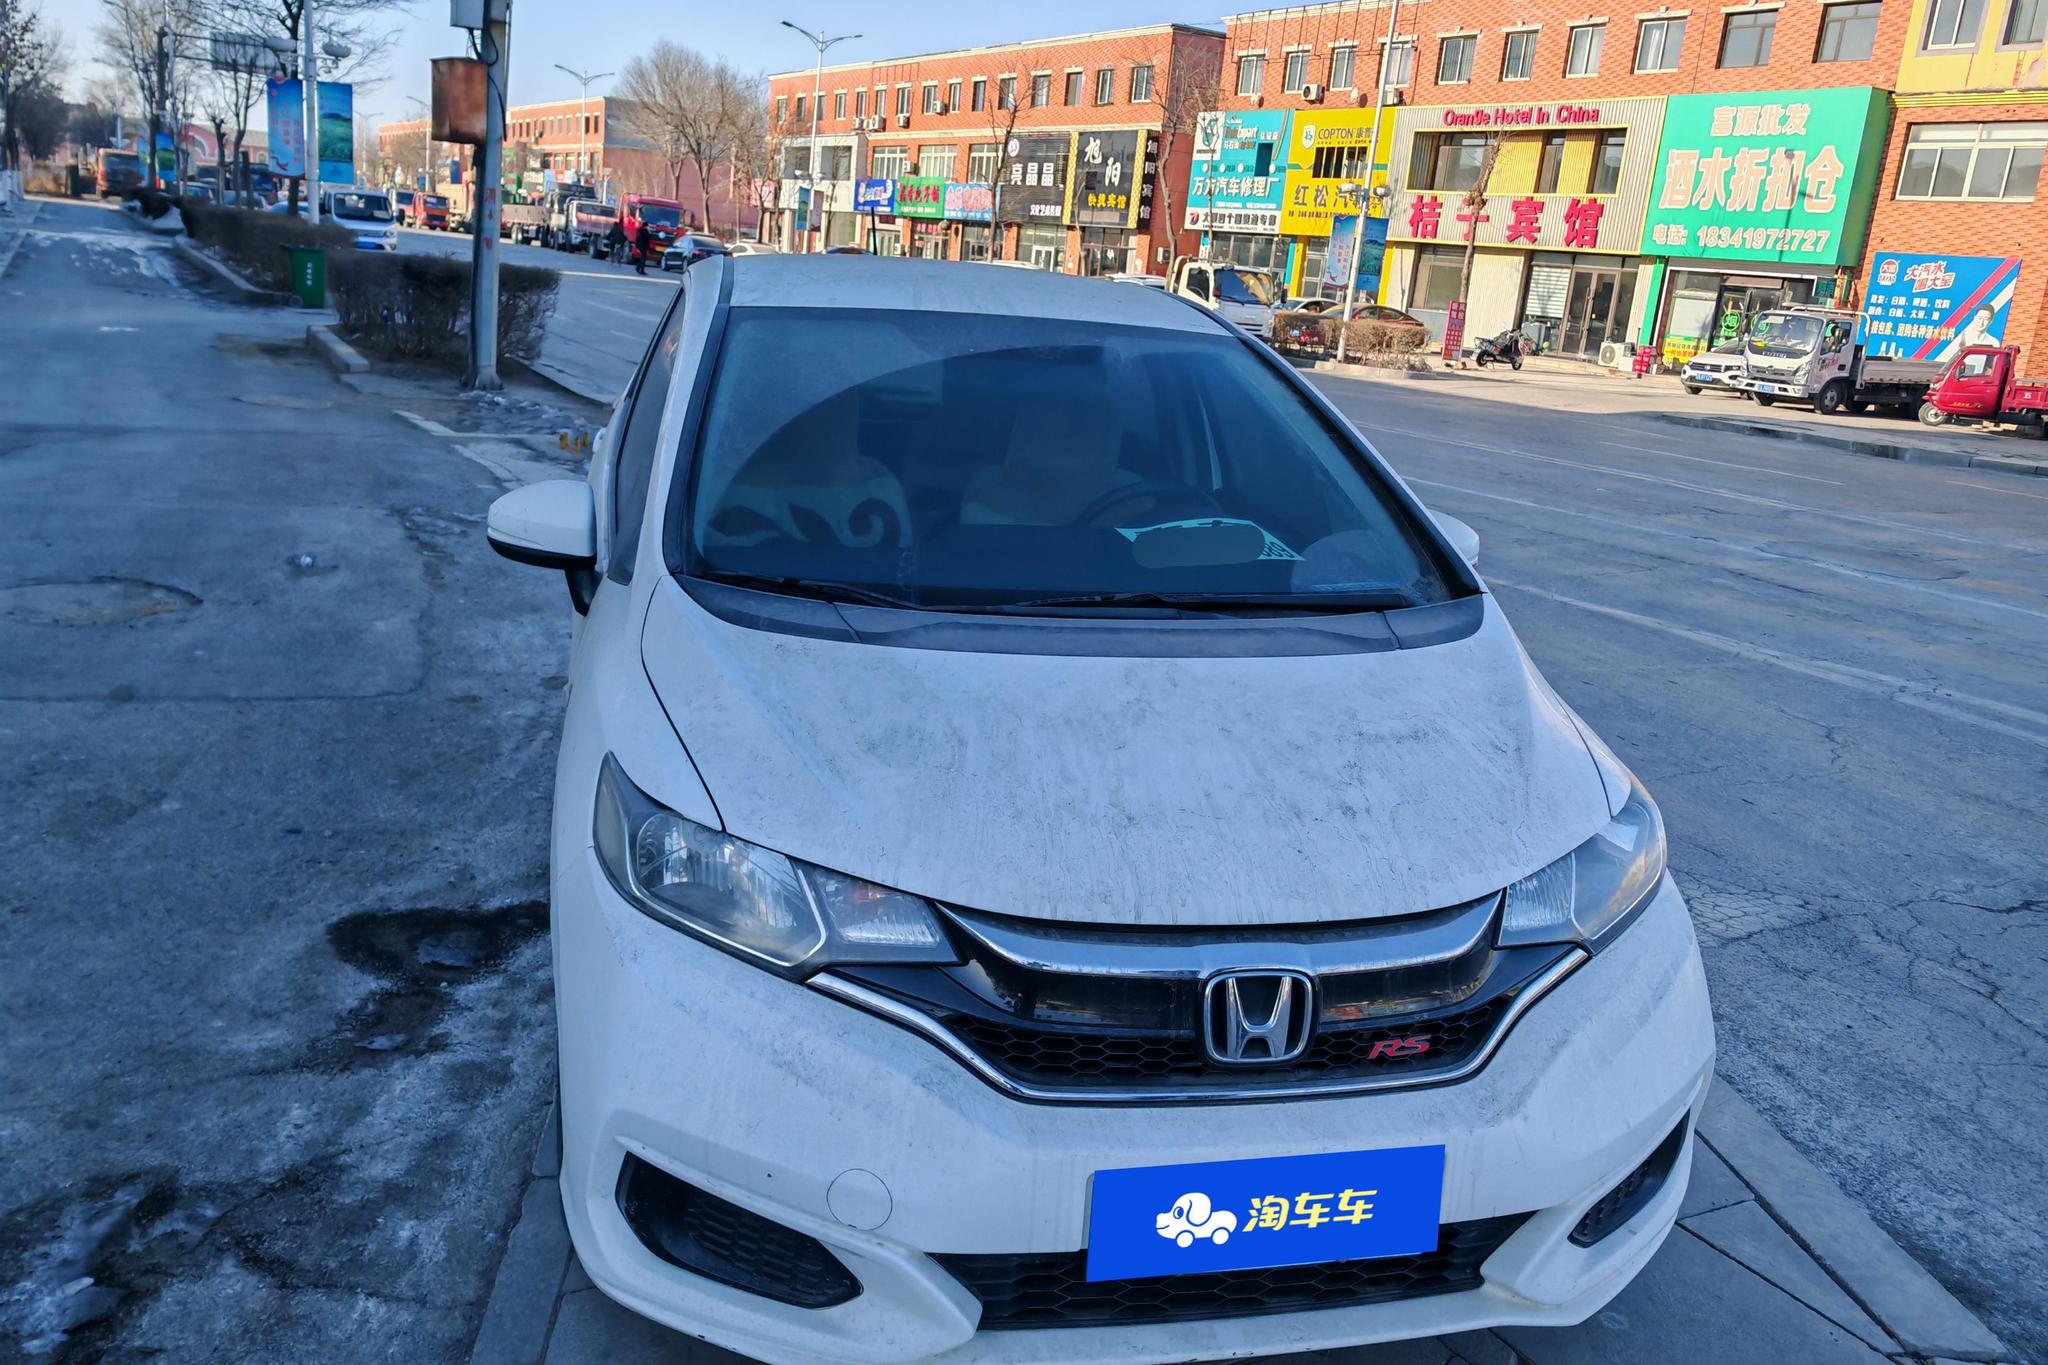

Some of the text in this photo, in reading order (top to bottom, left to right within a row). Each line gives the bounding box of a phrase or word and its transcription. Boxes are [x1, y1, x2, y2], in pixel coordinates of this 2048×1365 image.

[1443, 107, 1491, 126] Orange
[1493, 107, 1533, 125] Hotel
[1556, 104, 1600, 123] China
[1710, 103, 1811, 137] 富源批发
[1318, 128, 1353, 140] COPTON
[1010, 162, 1055, 187] 亮晶晶
[1084, 136, 1122, 187] 旭阳
[1139, 139, 1158, 219] 旭阳宾馆
[1192, 175, 1281, 198] 万方汽车修理厂
[1658, 144, 1844, 213] 酒水折扣仓
[1697, 226, 1832, 253] 18341972727
[1906, 261, 1947, 281] 大汽水
[1367, 1034, 1432, 1060] RS
